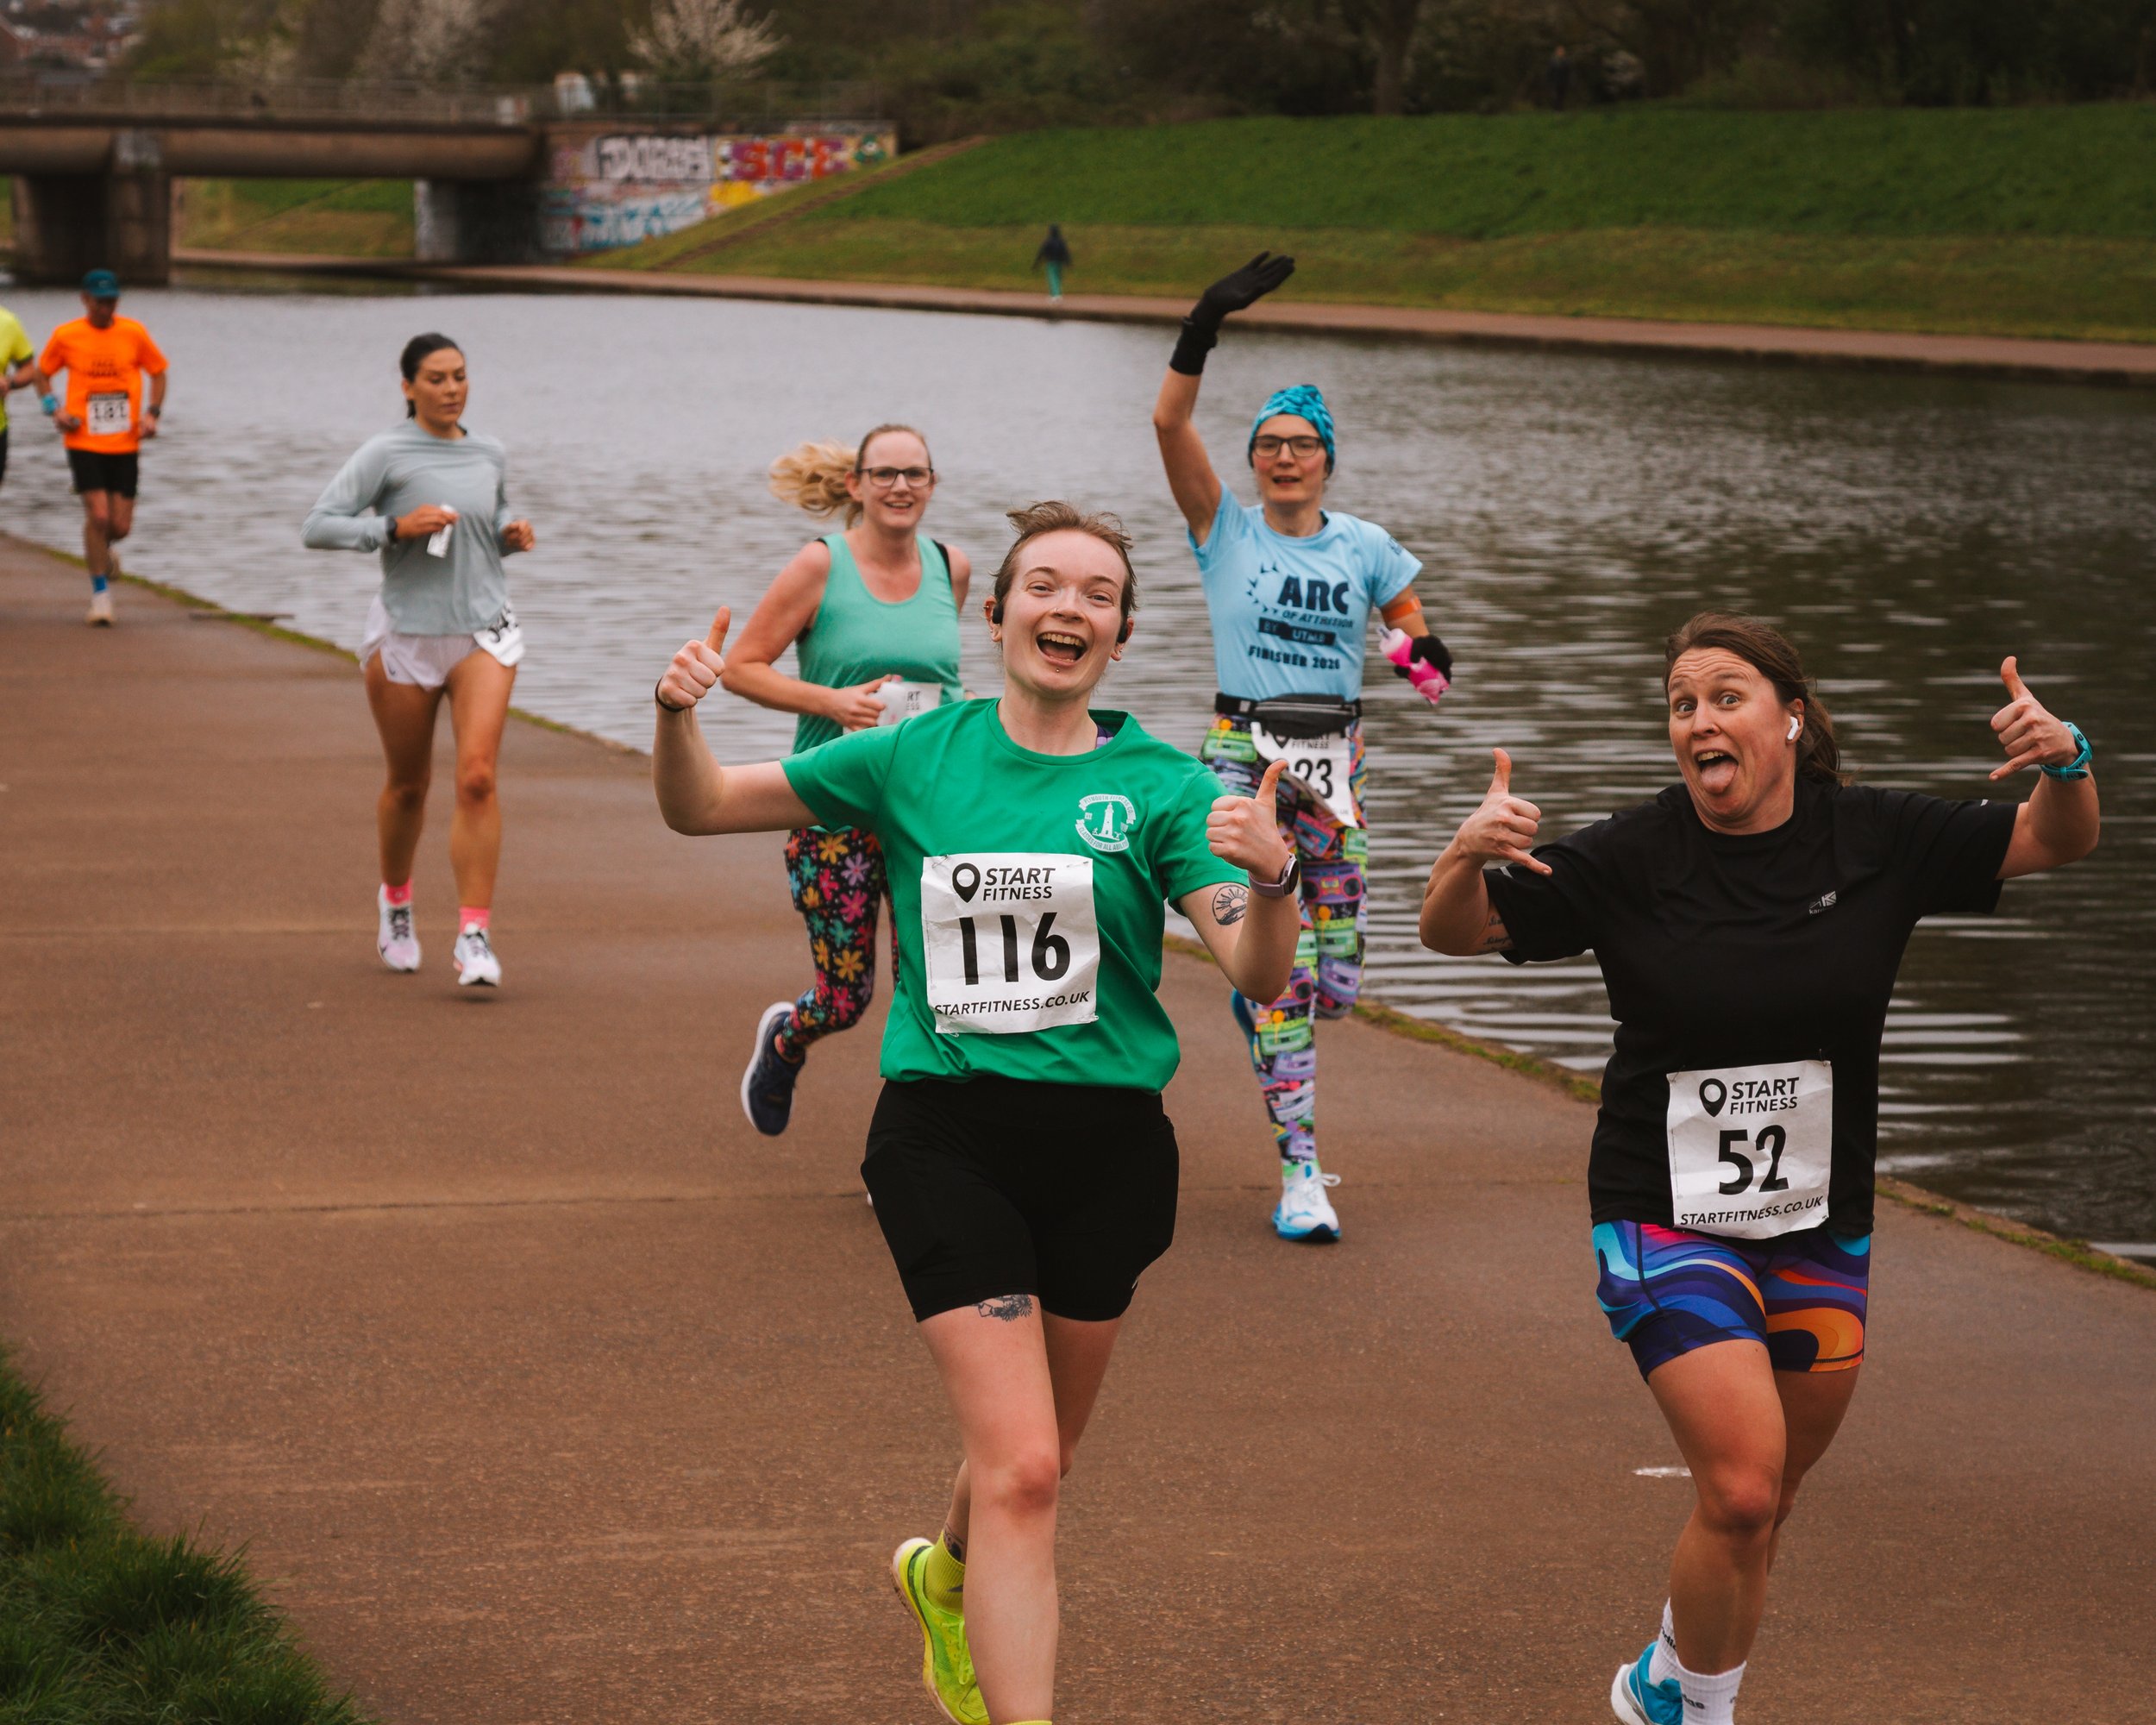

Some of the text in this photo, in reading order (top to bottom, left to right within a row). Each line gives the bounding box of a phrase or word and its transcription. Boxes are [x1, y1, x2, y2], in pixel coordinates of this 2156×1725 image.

[1277, 575, 1350, 615] ARC
[1282, 610, 1298, 619] OF
[1249, 645, 1307, 667] FINISHER
[985, 868, 1056, 886] START
[983, 886, 1052, 901] FITNESS
[959, 912, 1071, 986] 116
[935, 991, 1091, 1016] STARTFITNESS.CO.UK
[1731, 1077, 1800, 1099] START
[1730, 1096, 1797, 1115] FITNESS
[1718, 1124, 1789, 1195] 52
[1681, 1195, 1824, 1226] STARTFITNESS.CO.UK
